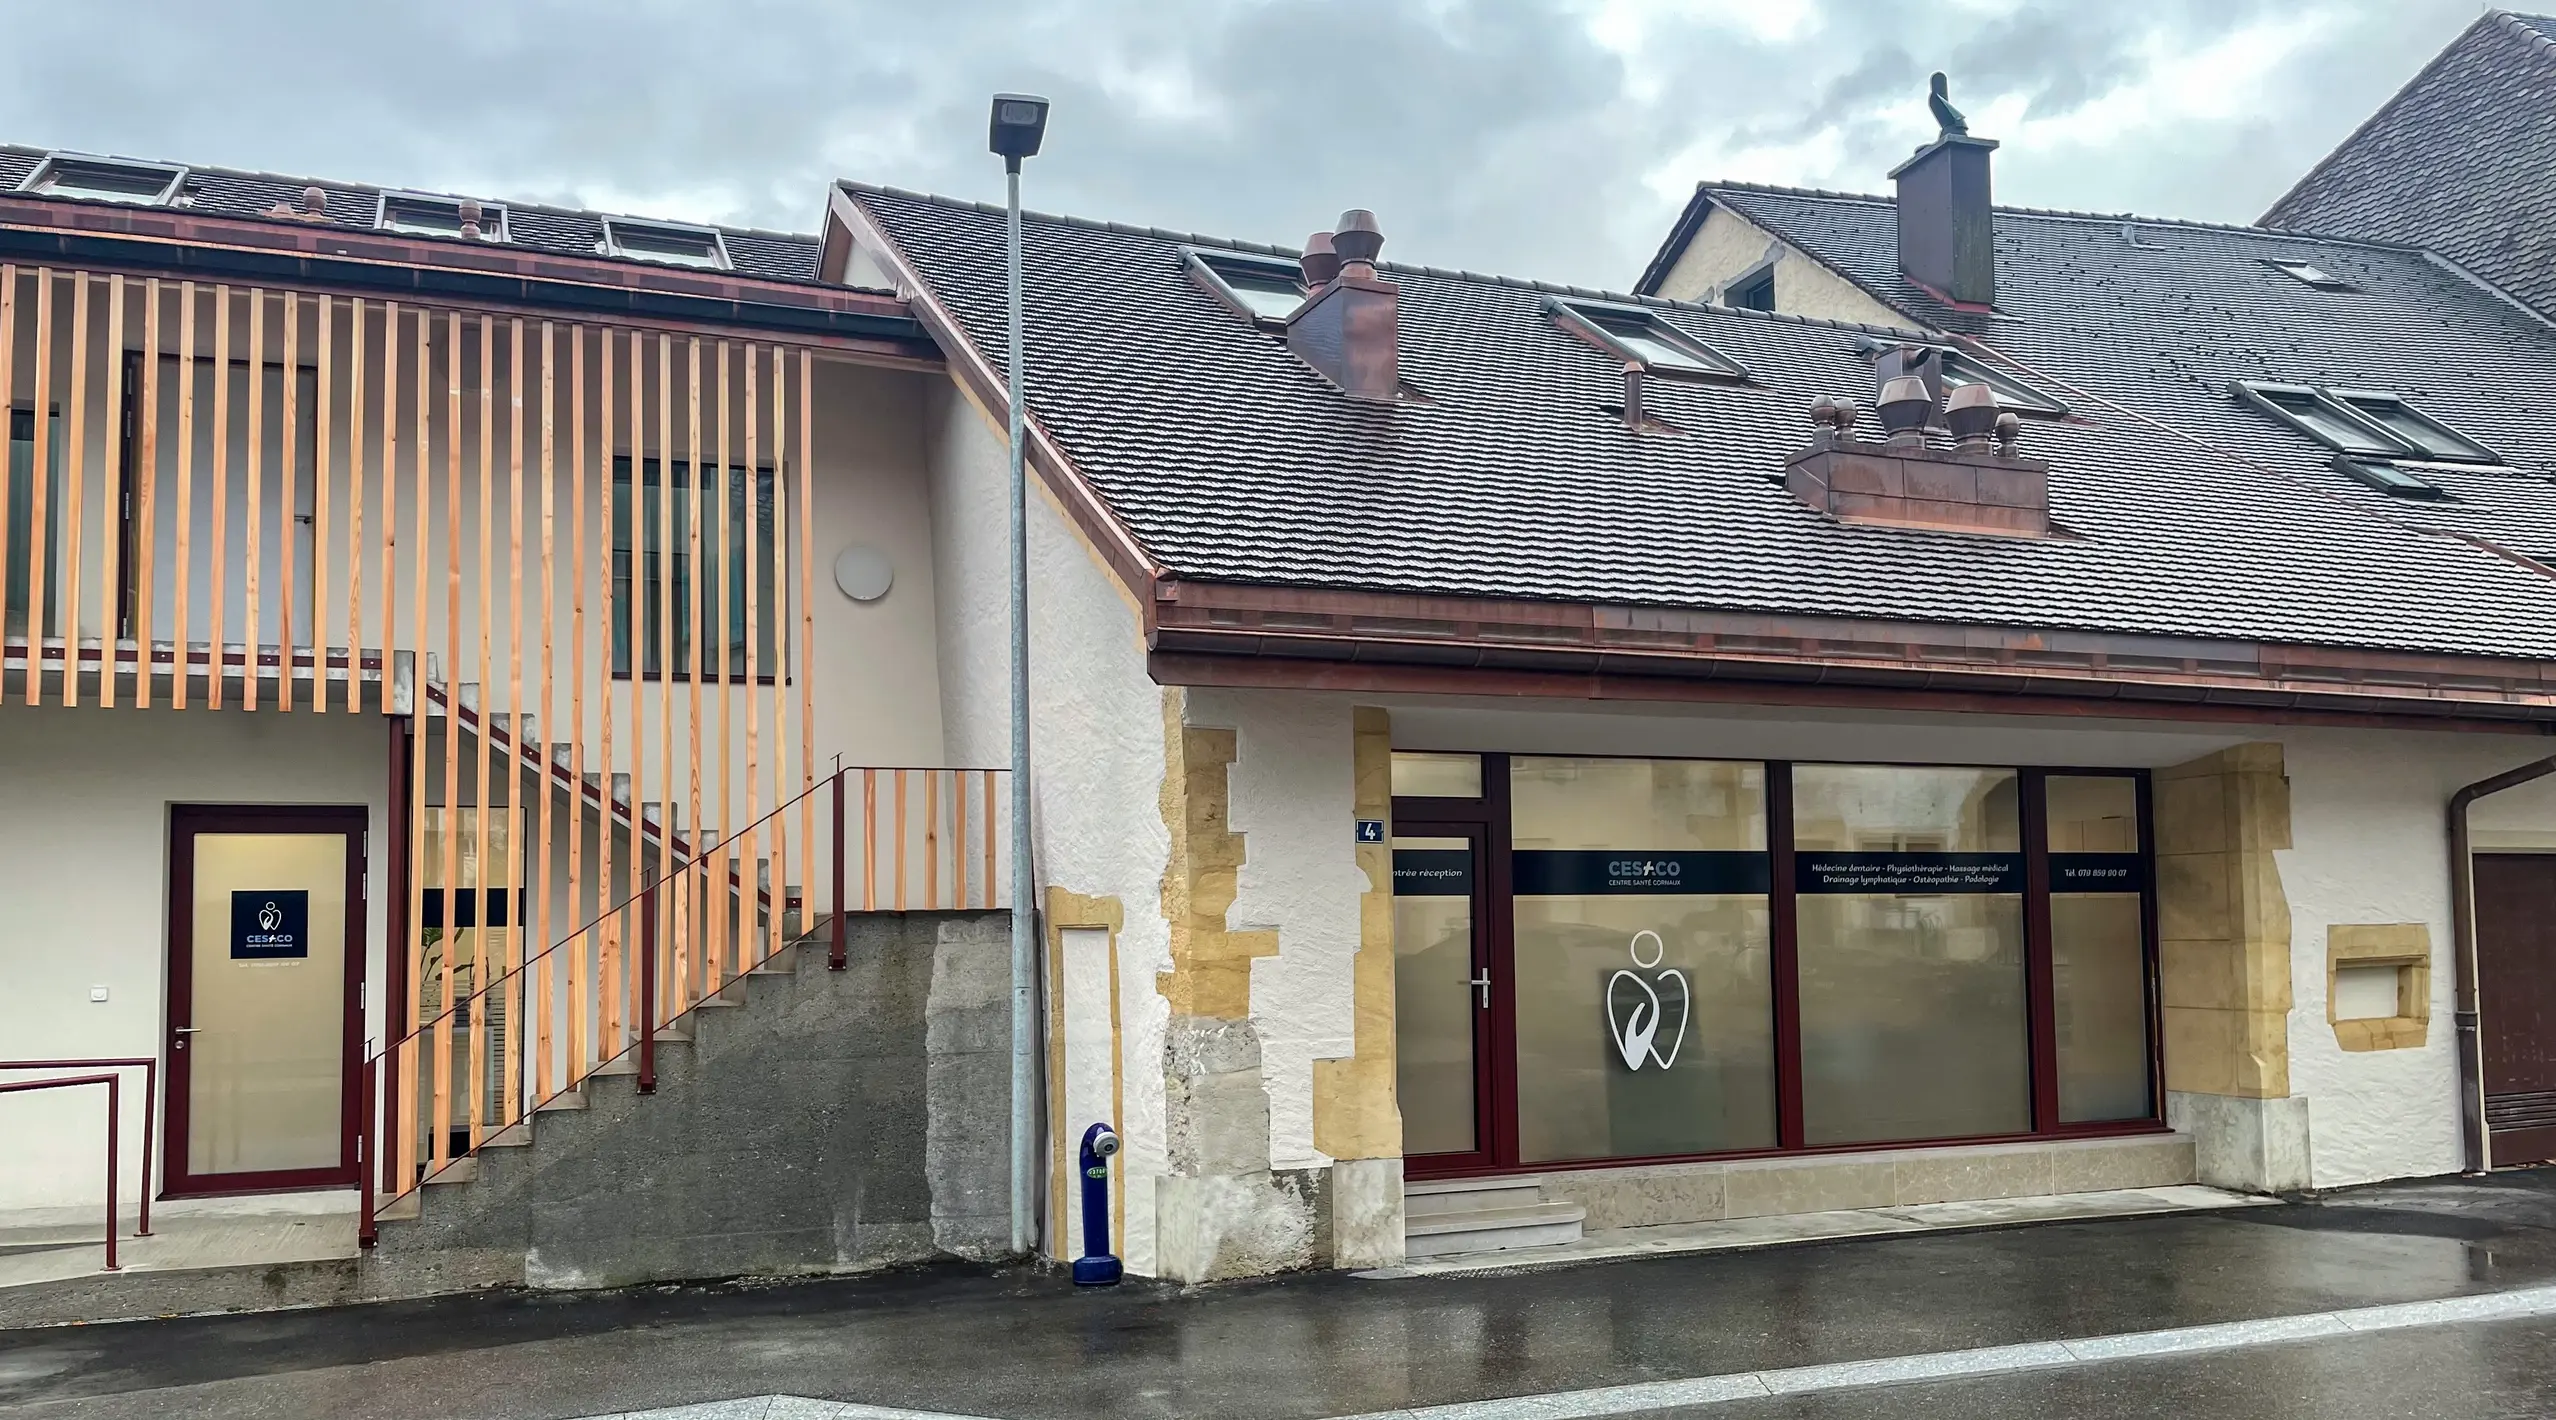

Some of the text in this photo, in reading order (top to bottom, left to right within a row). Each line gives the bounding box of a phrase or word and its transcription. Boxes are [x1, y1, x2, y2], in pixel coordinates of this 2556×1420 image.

[1364, 823, 1376, 840] 4
[1849, 863, 1881, 872] dentaire
[1392, 868, 1417, 877] ntrée
[2118, 869, 2127, 877] 07
[1823, 875, 1859, 886] Drainage
[1860, 875, 1907, 886] lymphatique
[1964, 875, 1999, 885] Podologie
